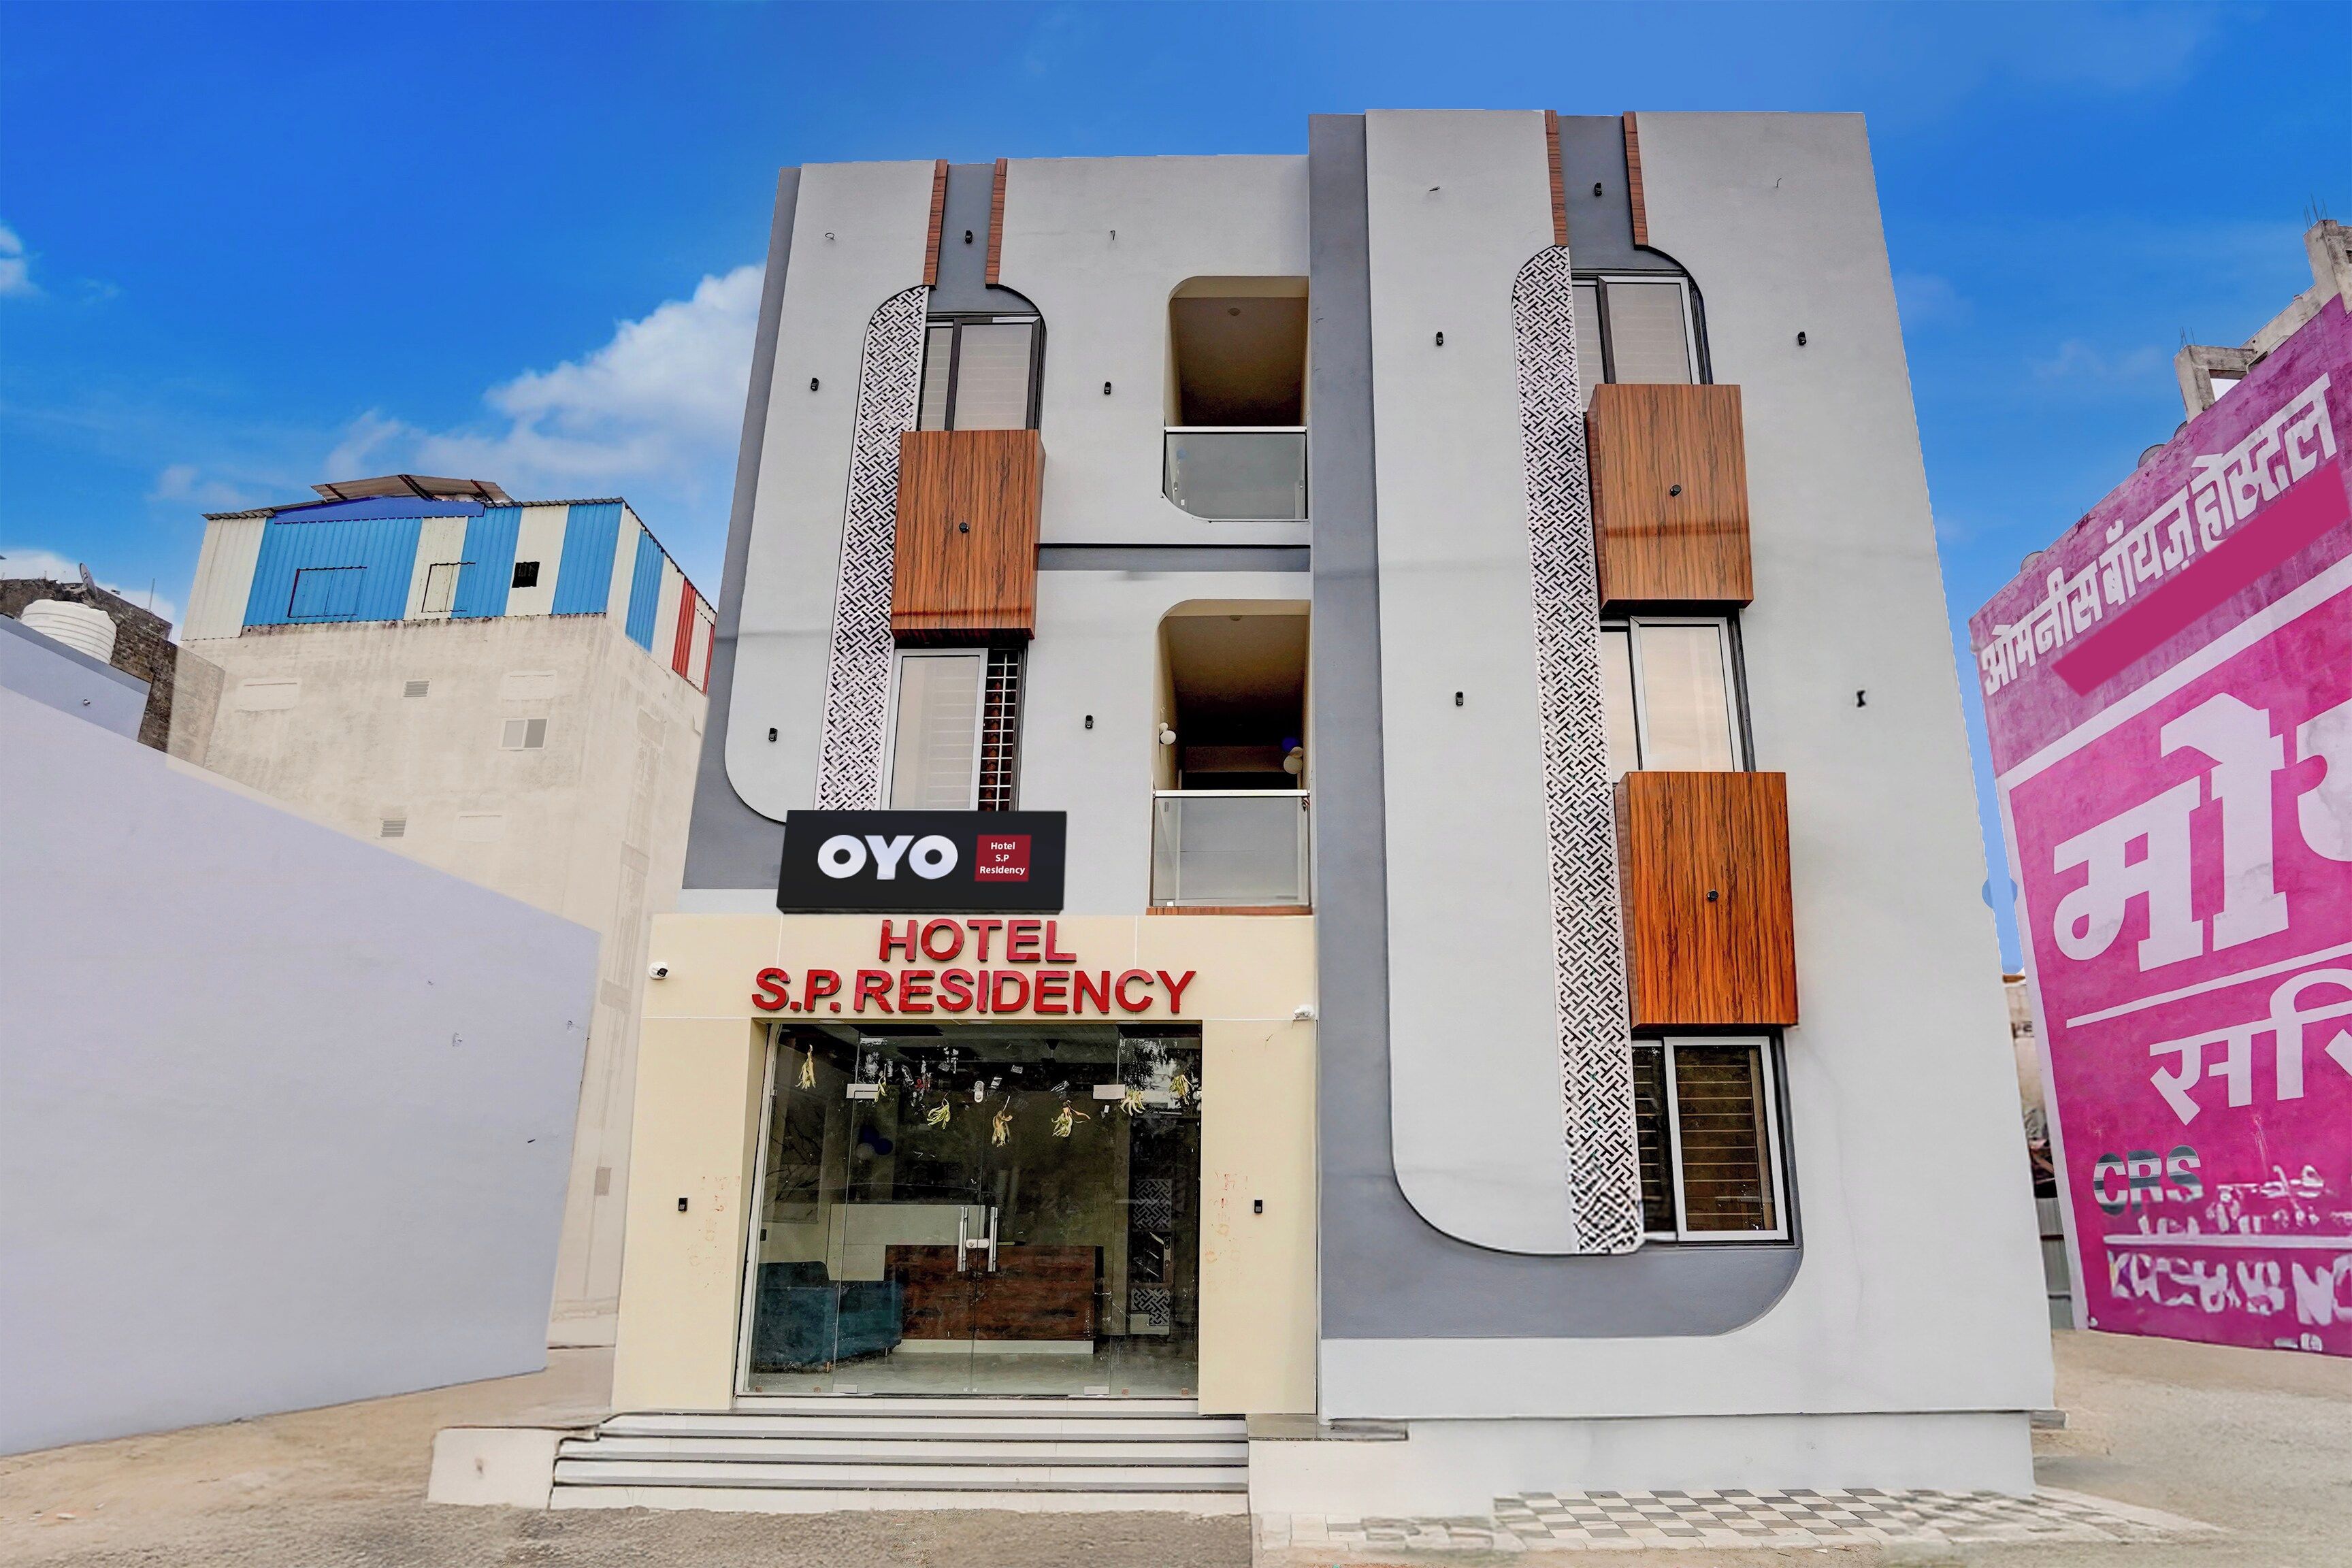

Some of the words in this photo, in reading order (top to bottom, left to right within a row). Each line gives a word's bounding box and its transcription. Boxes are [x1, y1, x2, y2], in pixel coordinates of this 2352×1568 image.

[817, 834, 958, 880] OYO
[990, 841, 1016, 850] Hotel
[995, 853, 1010, 862] S.P
[979, 865, 1026, 876] Residency
[879, 919, 1077, 963] HOTEL
[751, 967, 842, 1013] S.P.
[853, 968, 1197, 1014] RESIDENCY
[2093, 1145, 2204, 1215] CRS
